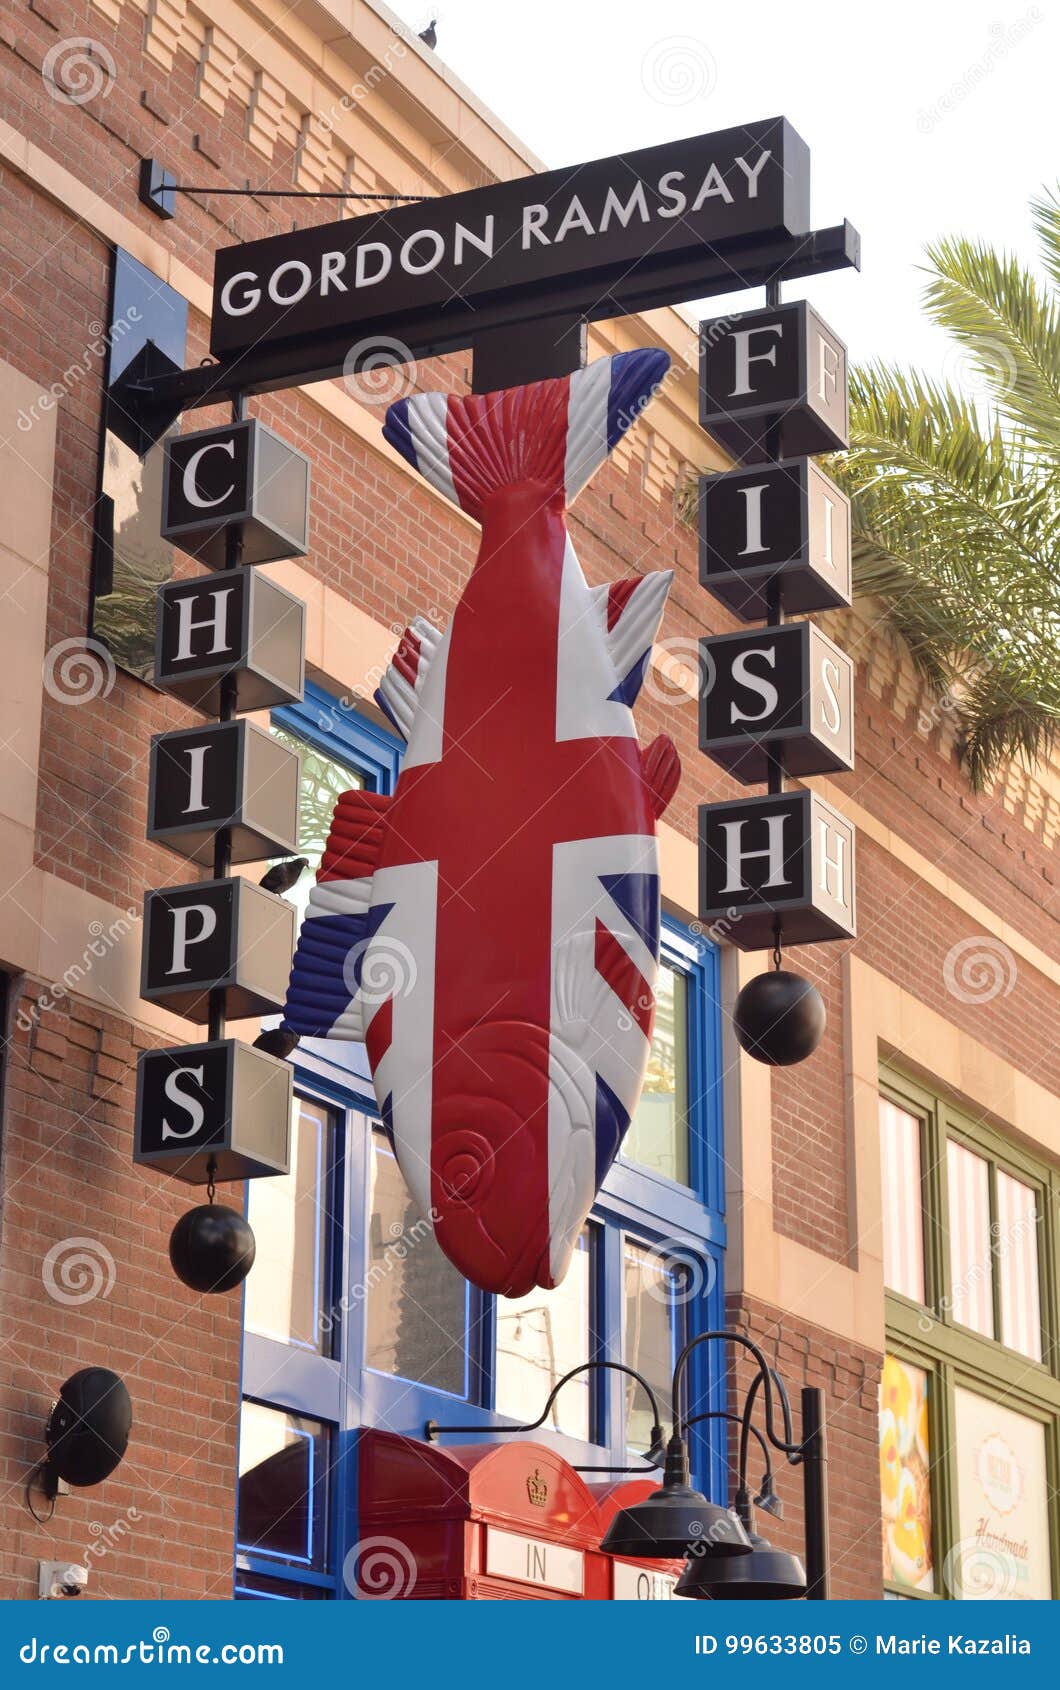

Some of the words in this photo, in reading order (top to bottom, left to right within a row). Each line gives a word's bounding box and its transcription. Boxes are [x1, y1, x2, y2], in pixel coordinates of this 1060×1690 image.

[220, 214, 495, 318] GORDON
[522, 150, 772, 251] RAMSAY
[161, 438, 235, 1142] CHIPS
[717, 323, 793, 894] FISH
[816, 329, 848, 910] FISH
[526, 1543, 547, 1582] IN
